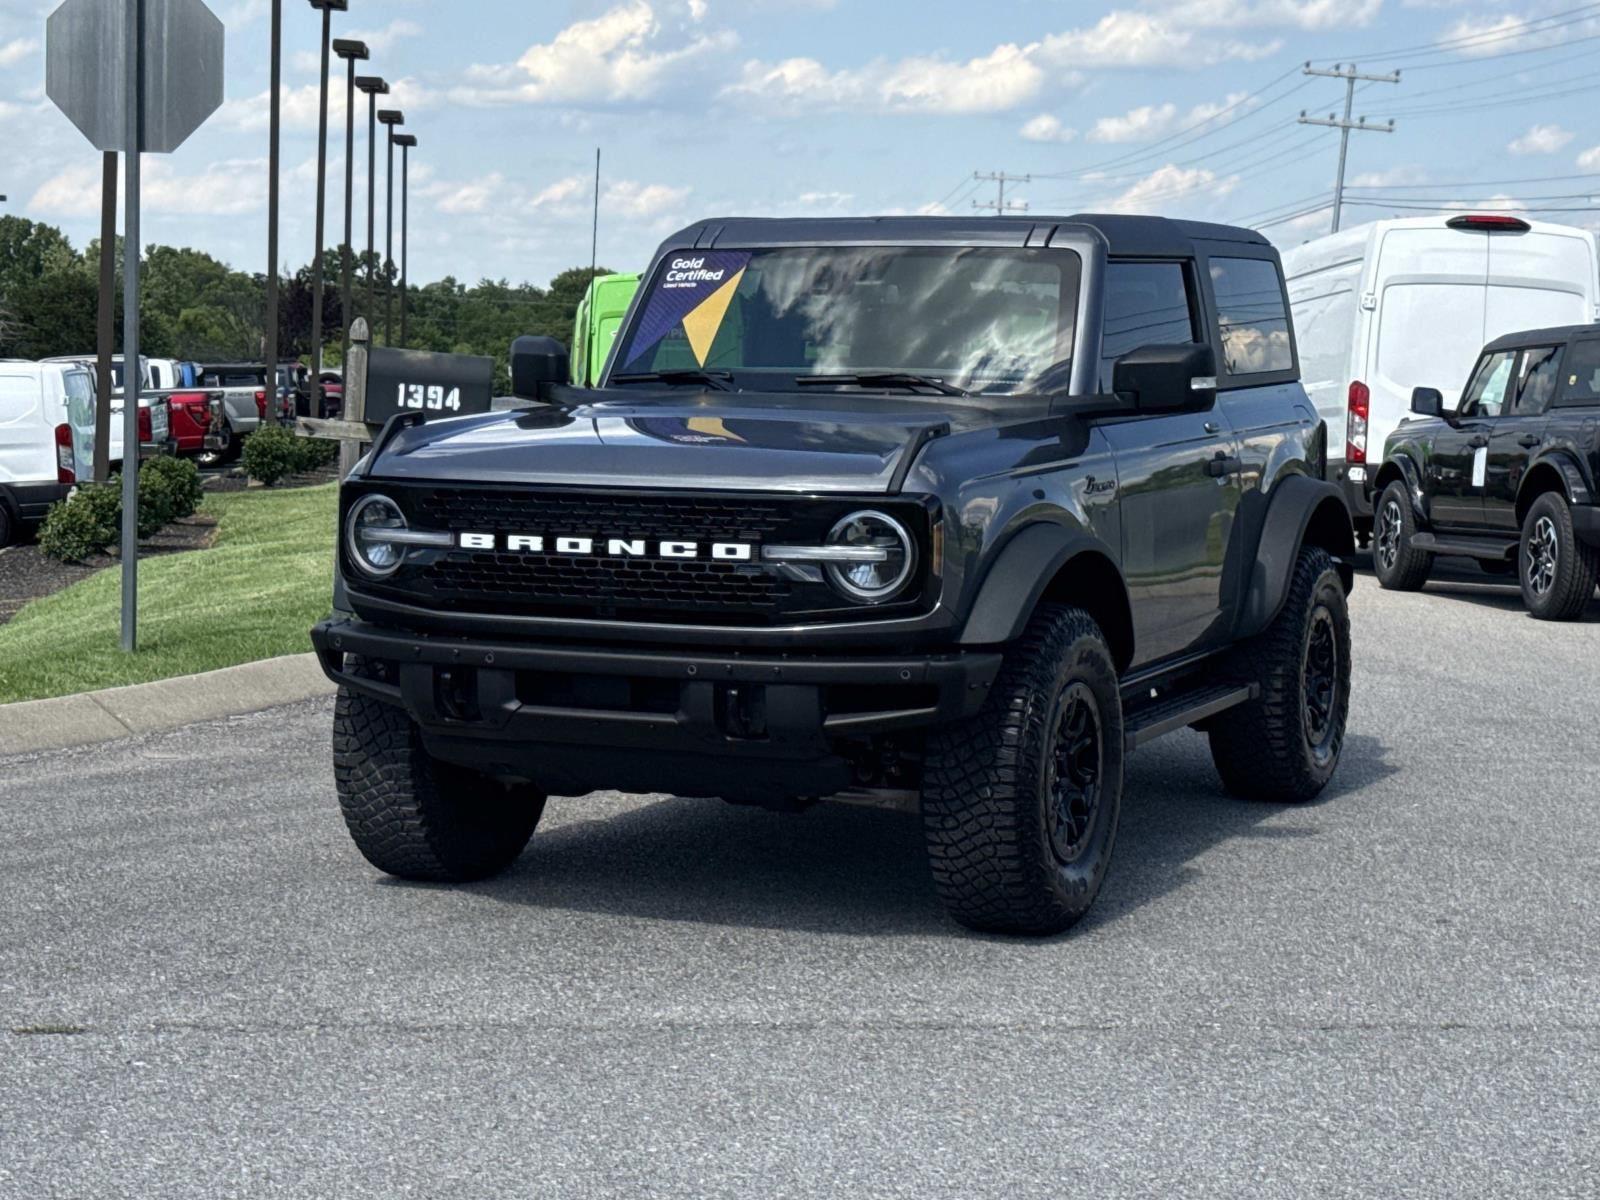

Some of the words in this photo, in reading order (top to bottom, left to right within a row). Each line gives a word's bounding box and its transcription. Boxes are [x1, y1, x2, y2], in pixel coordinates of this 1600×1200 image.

[671, 257, 705, 269] Gold
[666, 269, 724, 281] Certified
[397, 383, 461, 411] 1394
[459, 532, 752, 560] BRONCO
